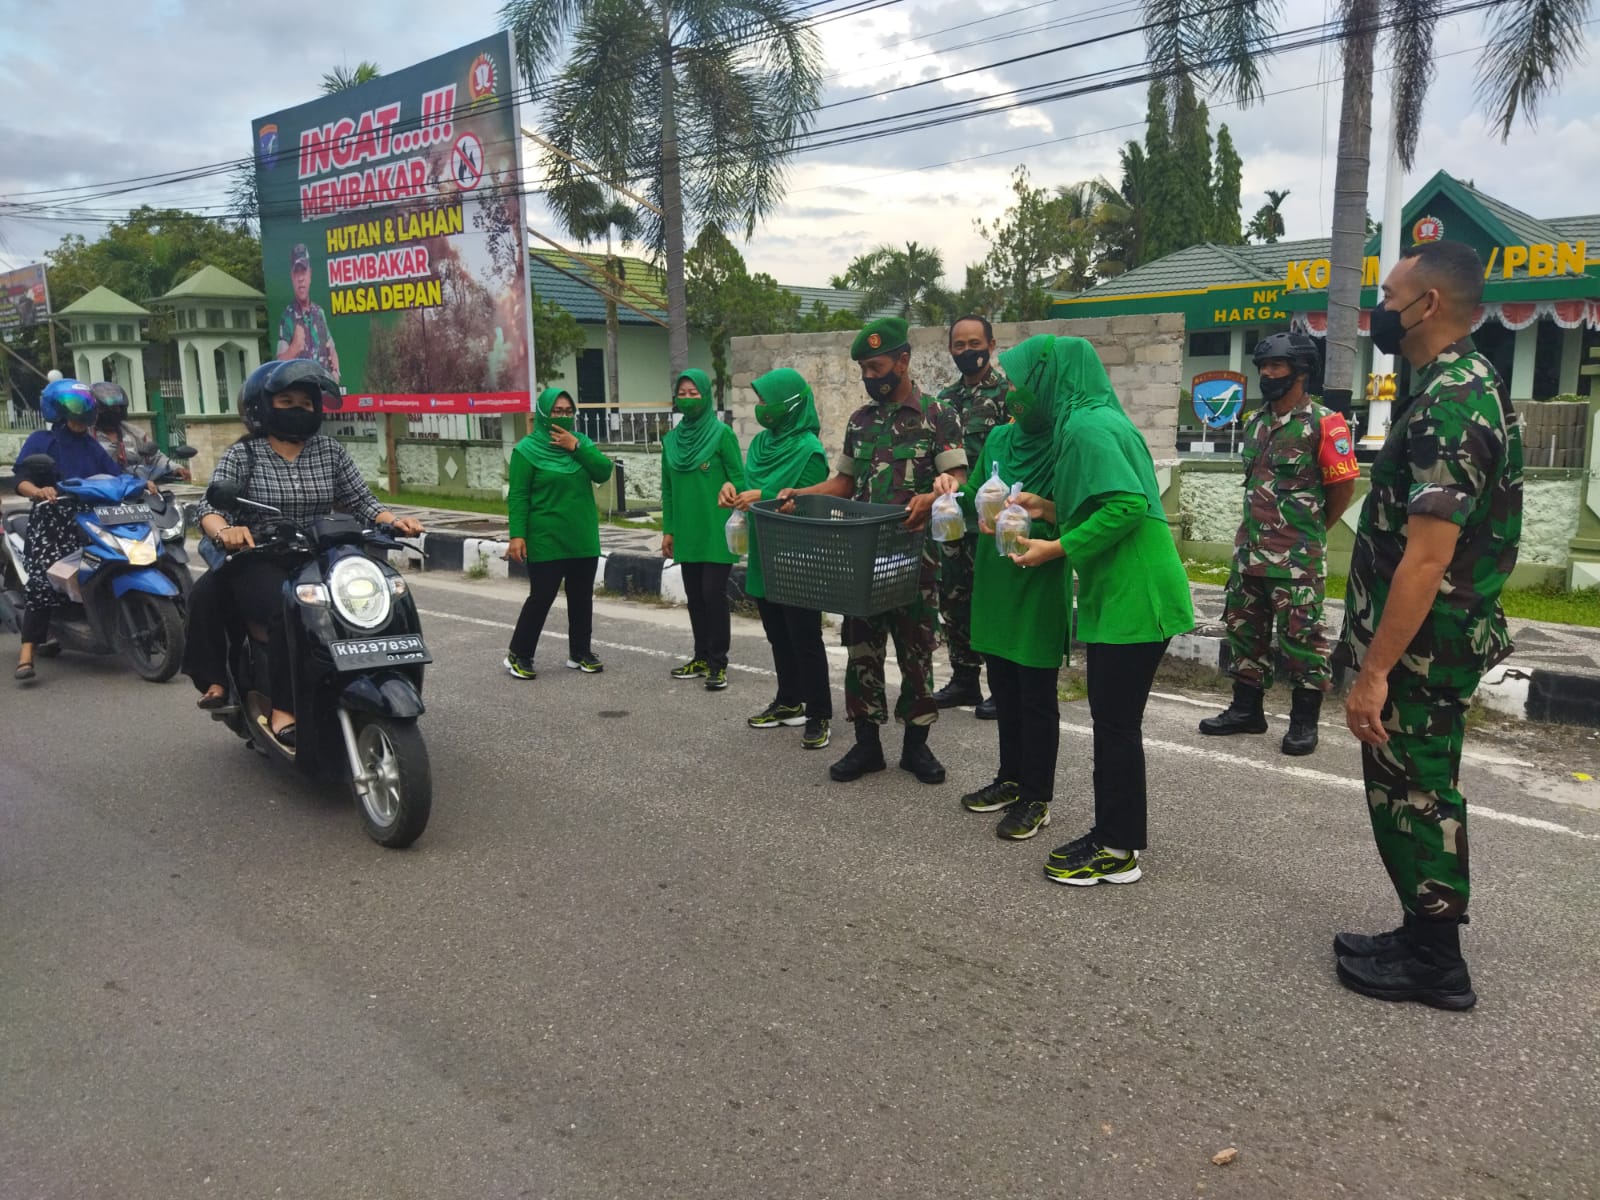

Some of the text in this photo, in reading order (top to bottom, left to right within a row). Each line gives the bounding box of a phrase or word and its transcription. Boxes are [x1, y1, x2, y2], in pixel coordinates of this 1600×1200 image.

[300, 159, 427, 219] MEMBAKAR
[326, 205, 463, 253] HUTAN & LAHAN
[328, 248, 430, 285] MEMBAKAR
[331, 279, 442, 315] MASA DEPAN
